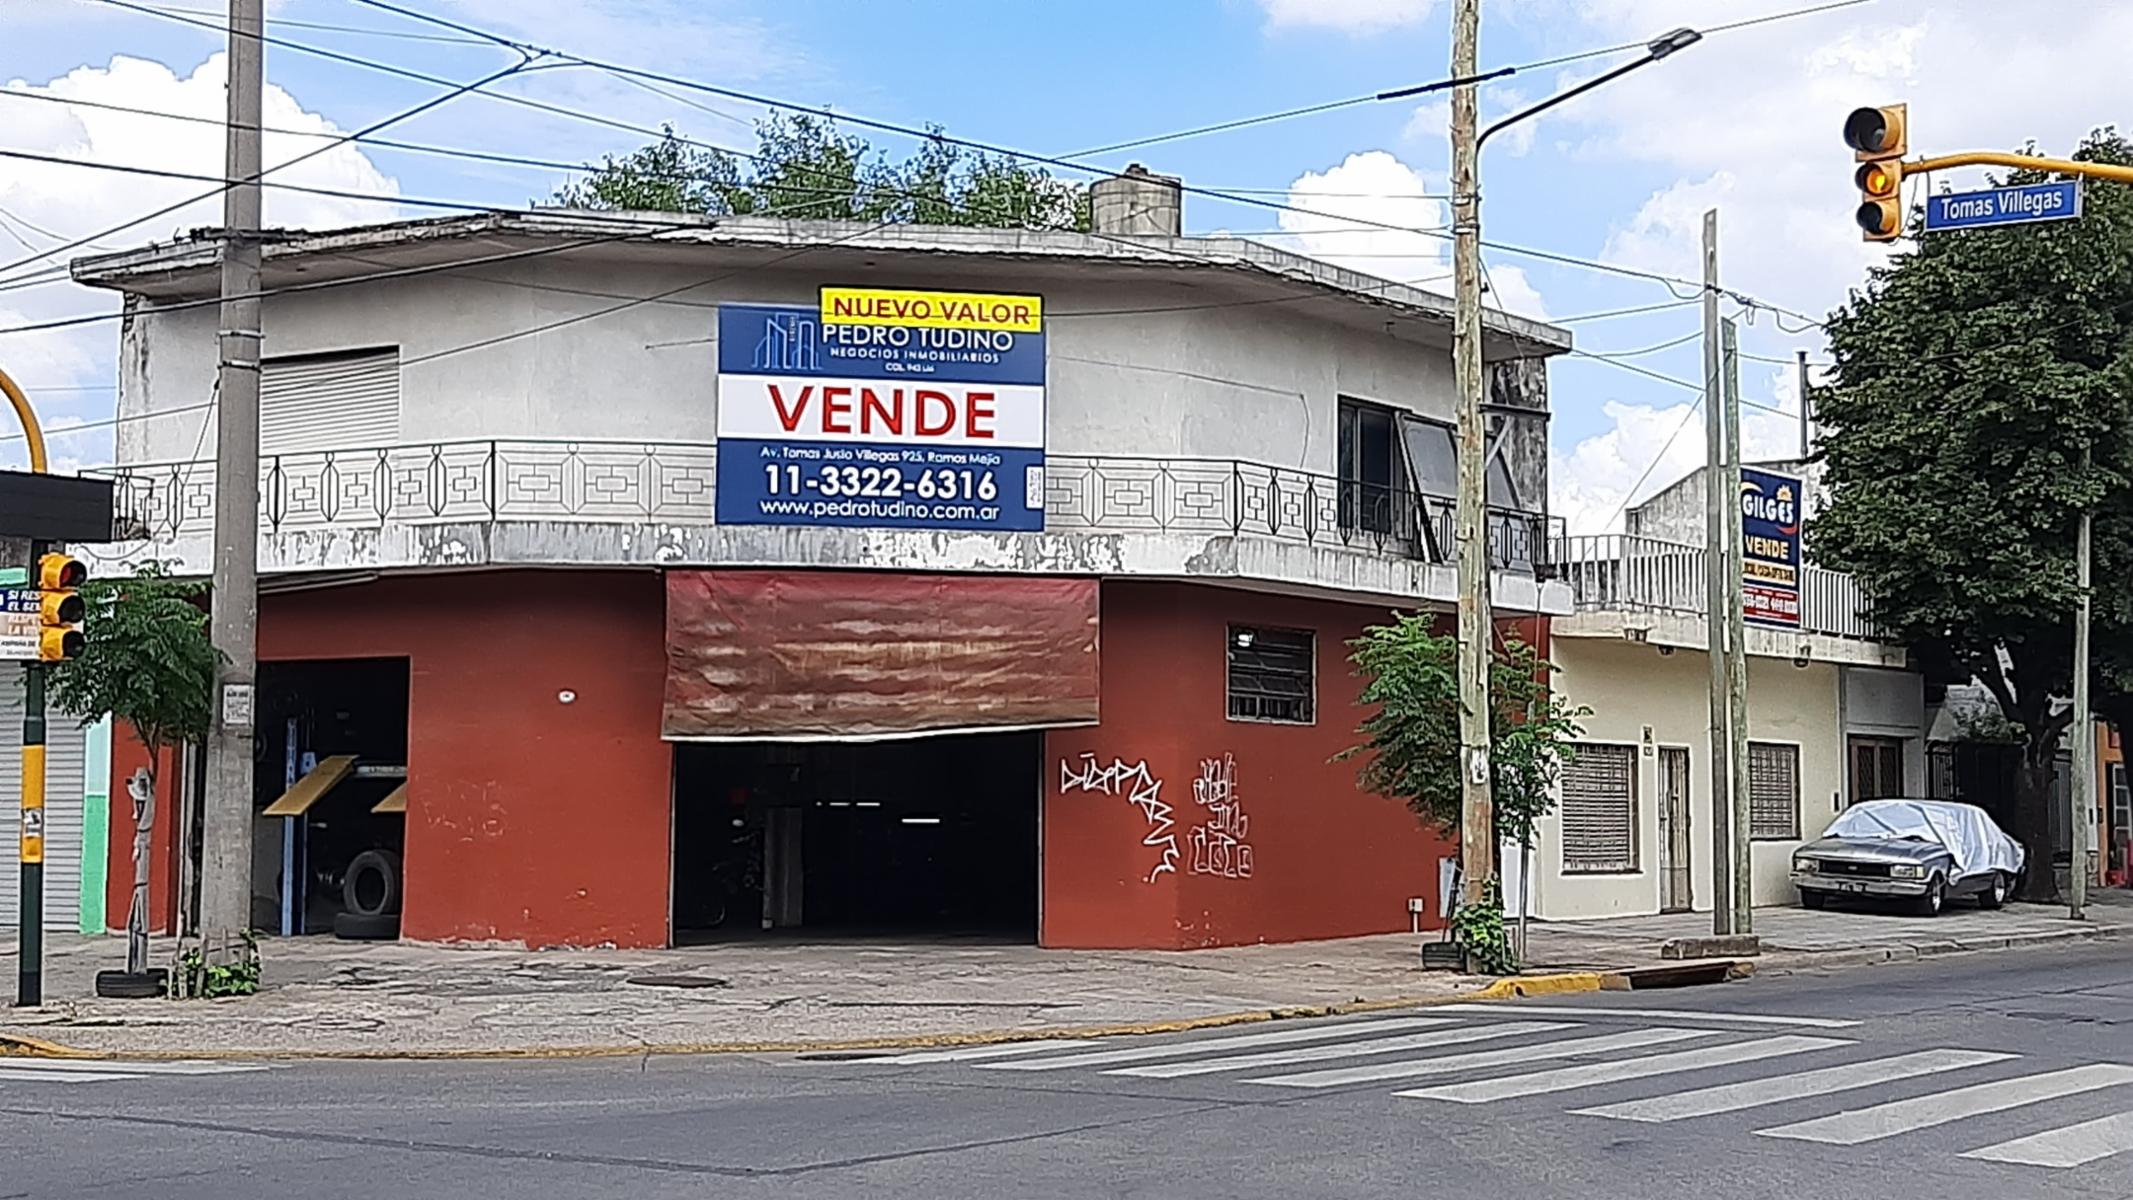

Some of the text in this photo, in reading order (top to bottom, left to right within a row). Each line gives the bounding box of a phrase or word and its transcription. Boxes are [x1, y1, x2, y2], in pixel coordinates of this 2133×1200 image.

[1941, 190, 2062, 220] Tomas Villegas
[833, 297, 1030, 325] NUEVO VALOR
[822, 324, 910, 347] PEDRO
[918, 327, 1014, 351] TUDINO
[830, 347, 999, 364] NEGOCIOS INMOBILIARIOS
[767, 384, 995, 438] VENDE
[760, 446, 780, 459] Av.
[855, 449, 899, 463] Villegas
[928, 452, 967, 464] Ramos
[765, 464, 997, 501] 11-3322-6316
[760, 499, 1000, 522] www.pedrotudino.com.ar
[1745, 535, 1789, 560] VENDE
[21, 590, 41, 601] RES
